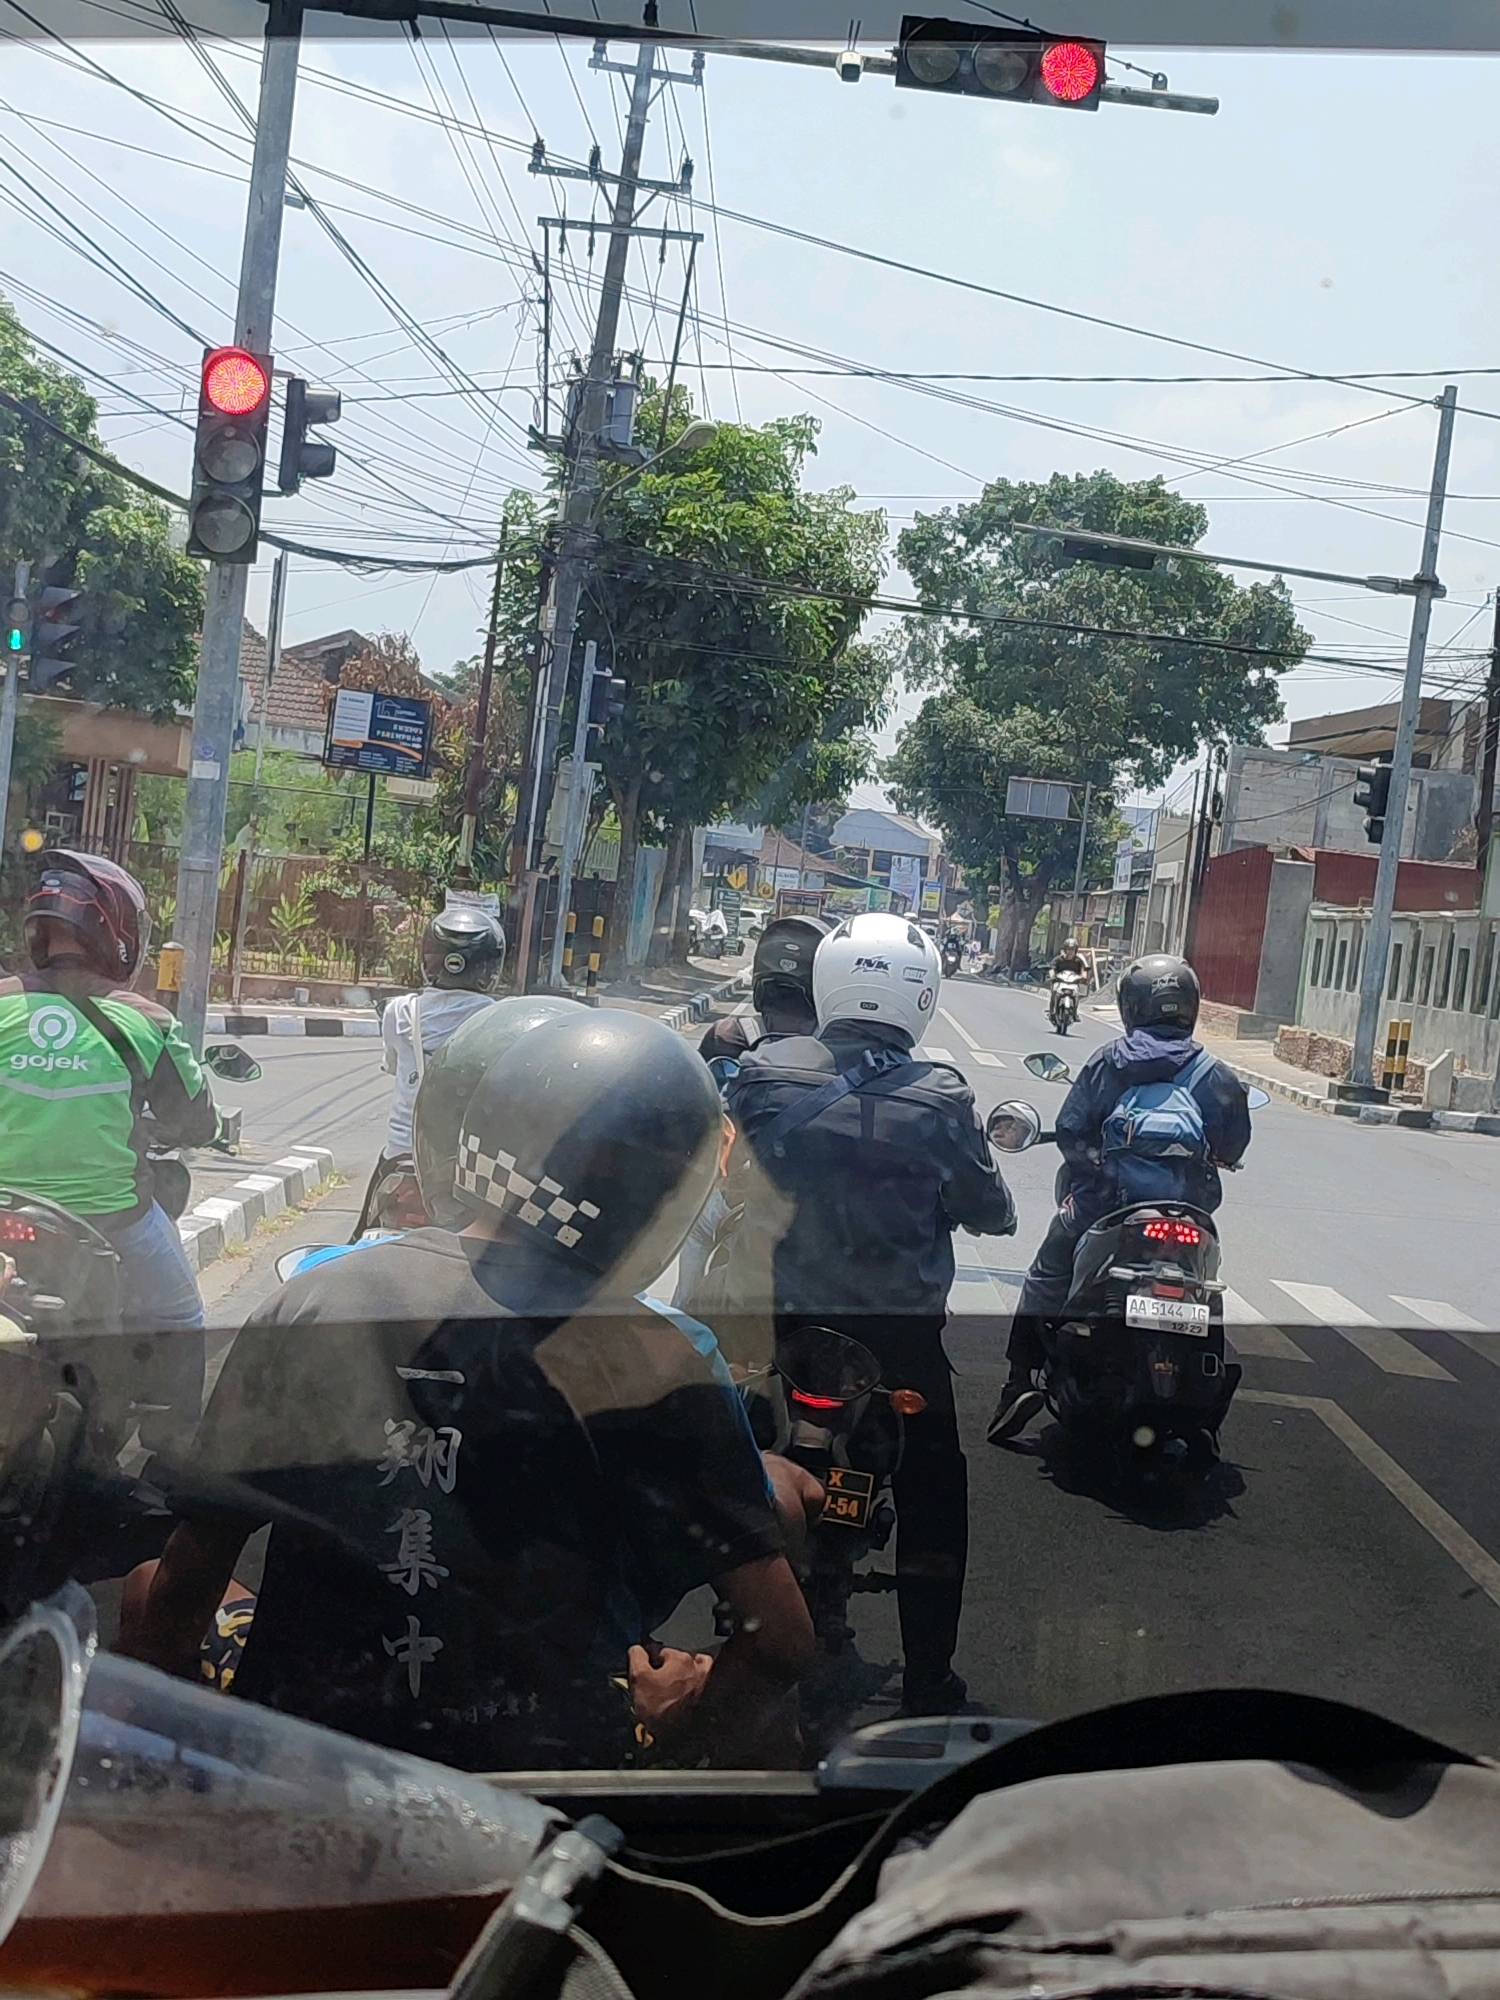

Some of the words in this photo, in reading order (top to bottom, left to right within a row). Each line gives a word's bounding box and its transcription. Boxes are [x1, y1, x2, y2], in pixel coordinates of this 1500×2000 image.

[10, 1053, 89, 1072] gojek
[1129, 1298, 1147, 1315] AA
[1151, 1302, 1183, 1318] 5144
[1191, 1307, 1207, 1322] IG
